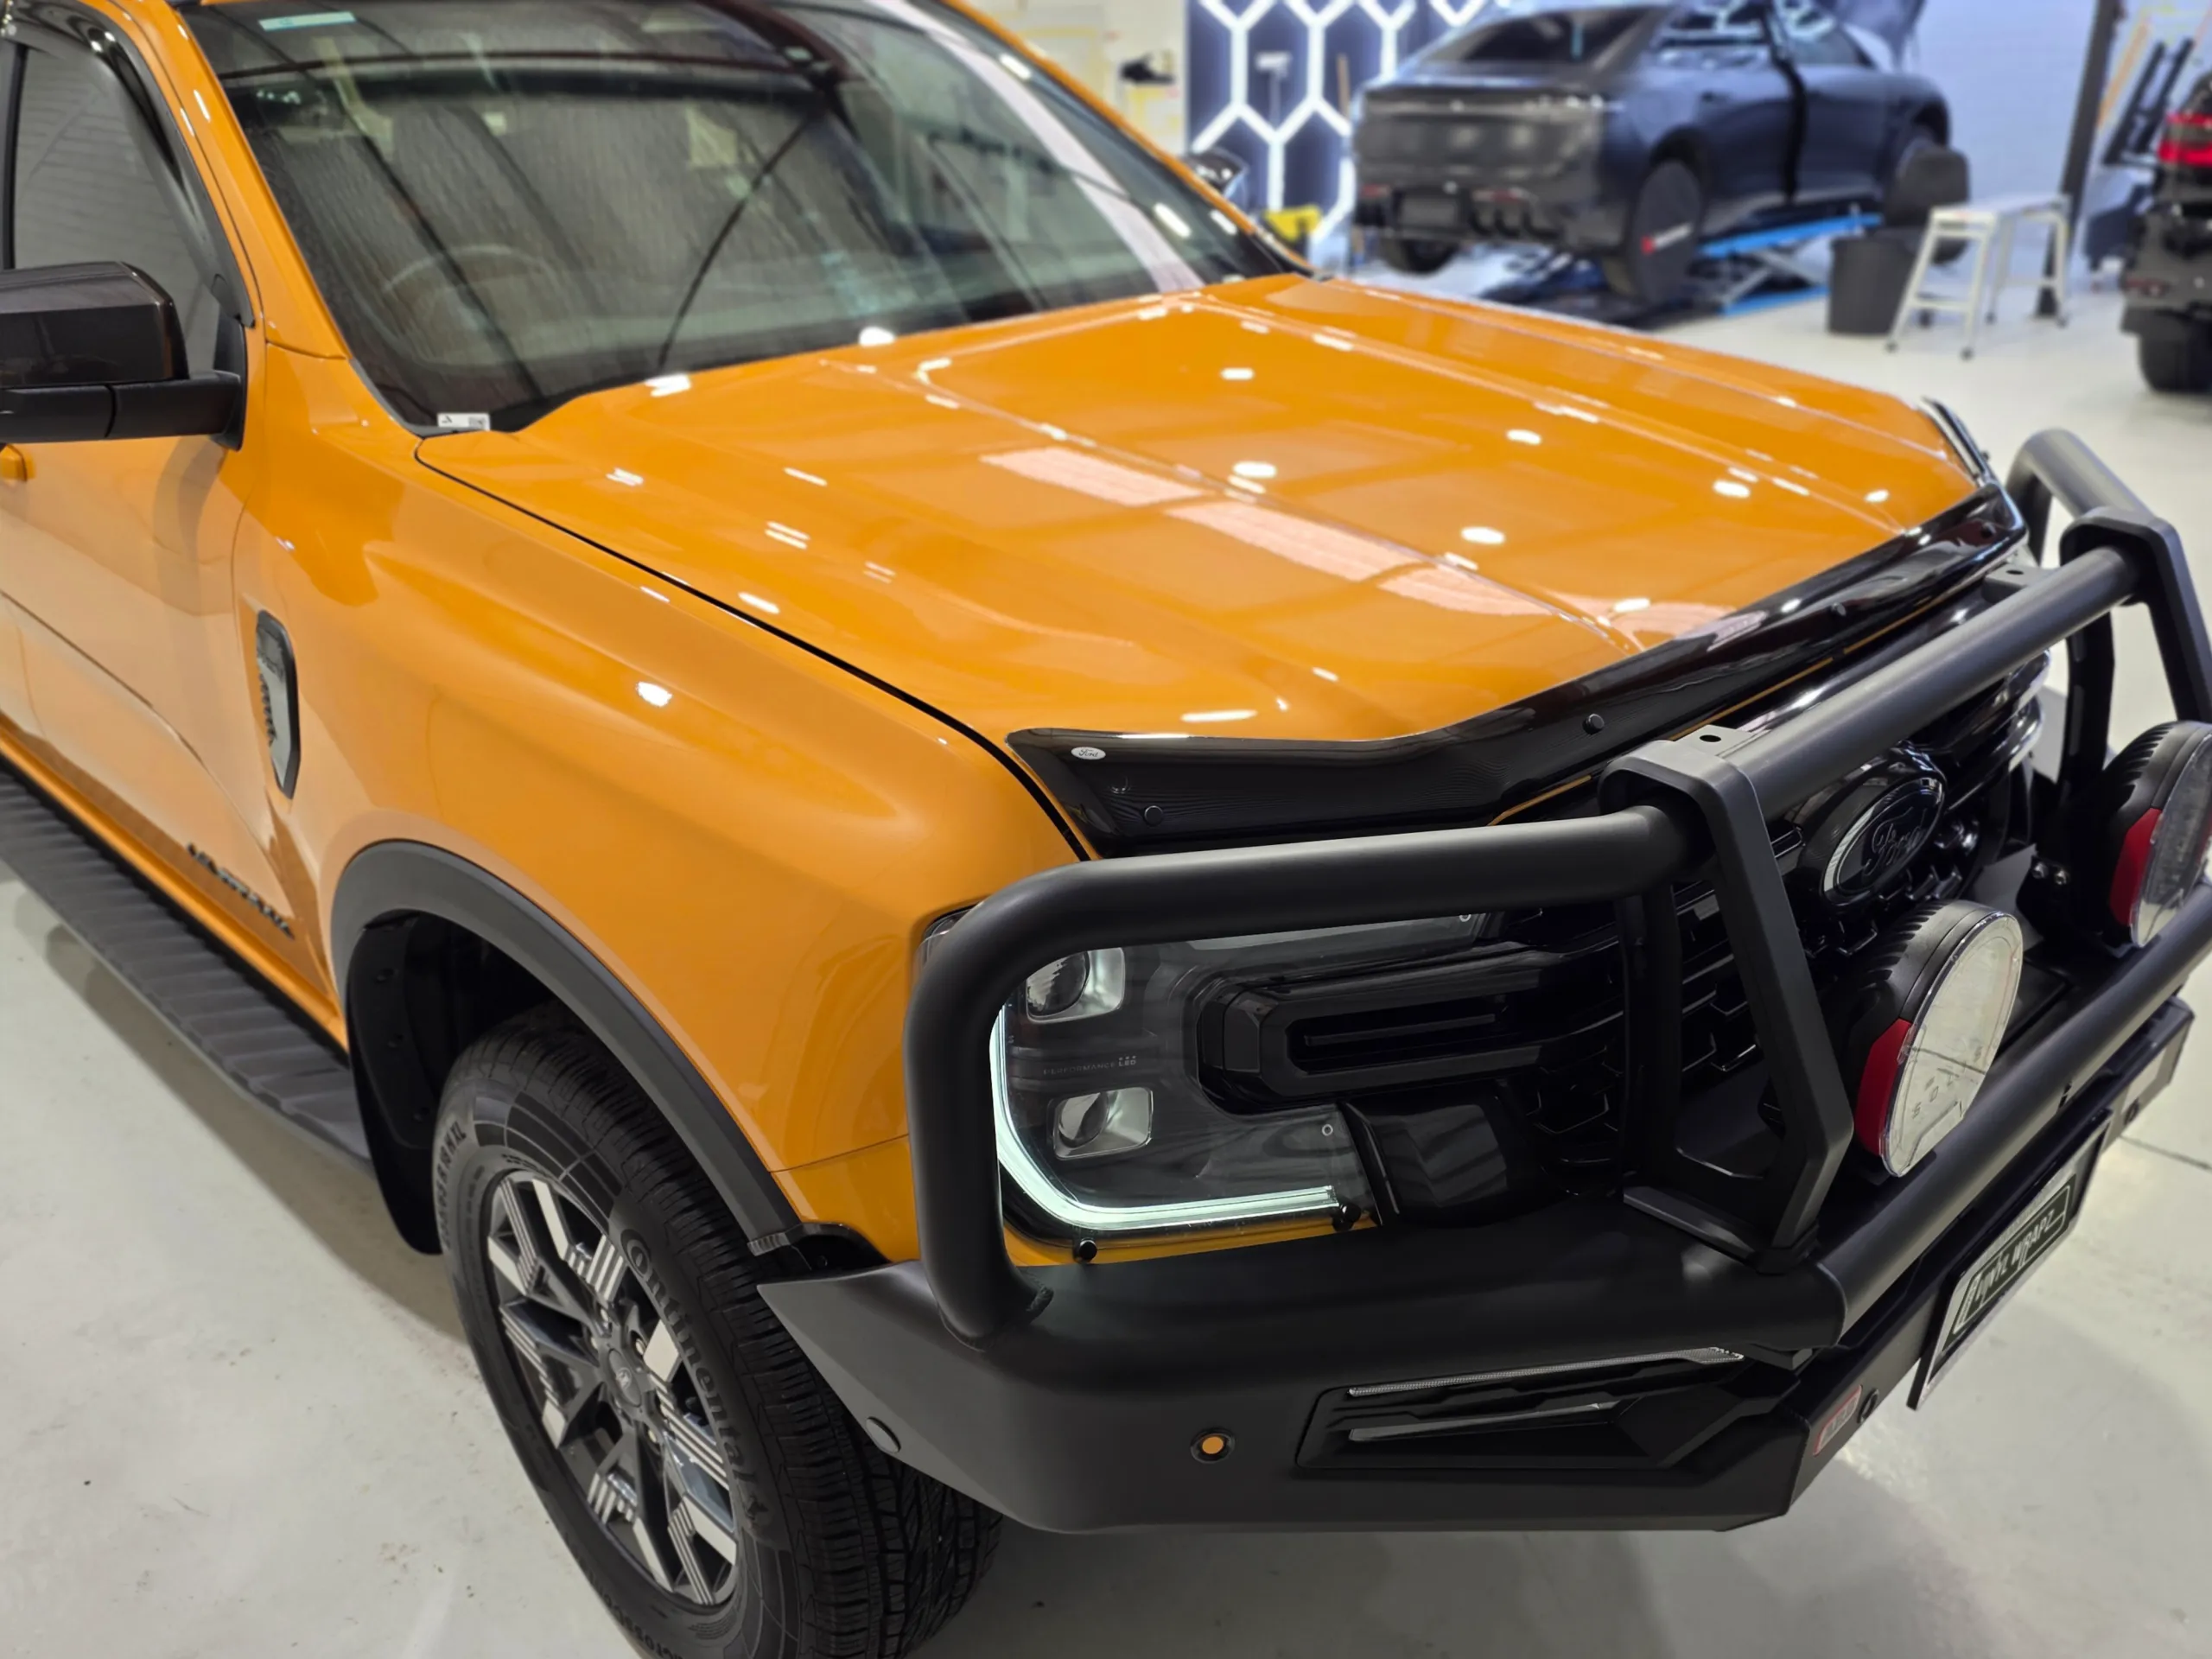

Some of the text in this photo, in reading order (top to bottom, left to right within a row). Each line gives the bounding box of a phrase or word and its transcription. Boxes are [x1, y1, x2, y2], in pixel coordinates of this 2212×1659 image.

[1078, 748, 1099, 758] Ford
[1861, 804, 1929, 877] Ford
[1043, 1058, 1136, 1075] PERFORMANCE LED
[620, 1227, 757, 1484] Continental
